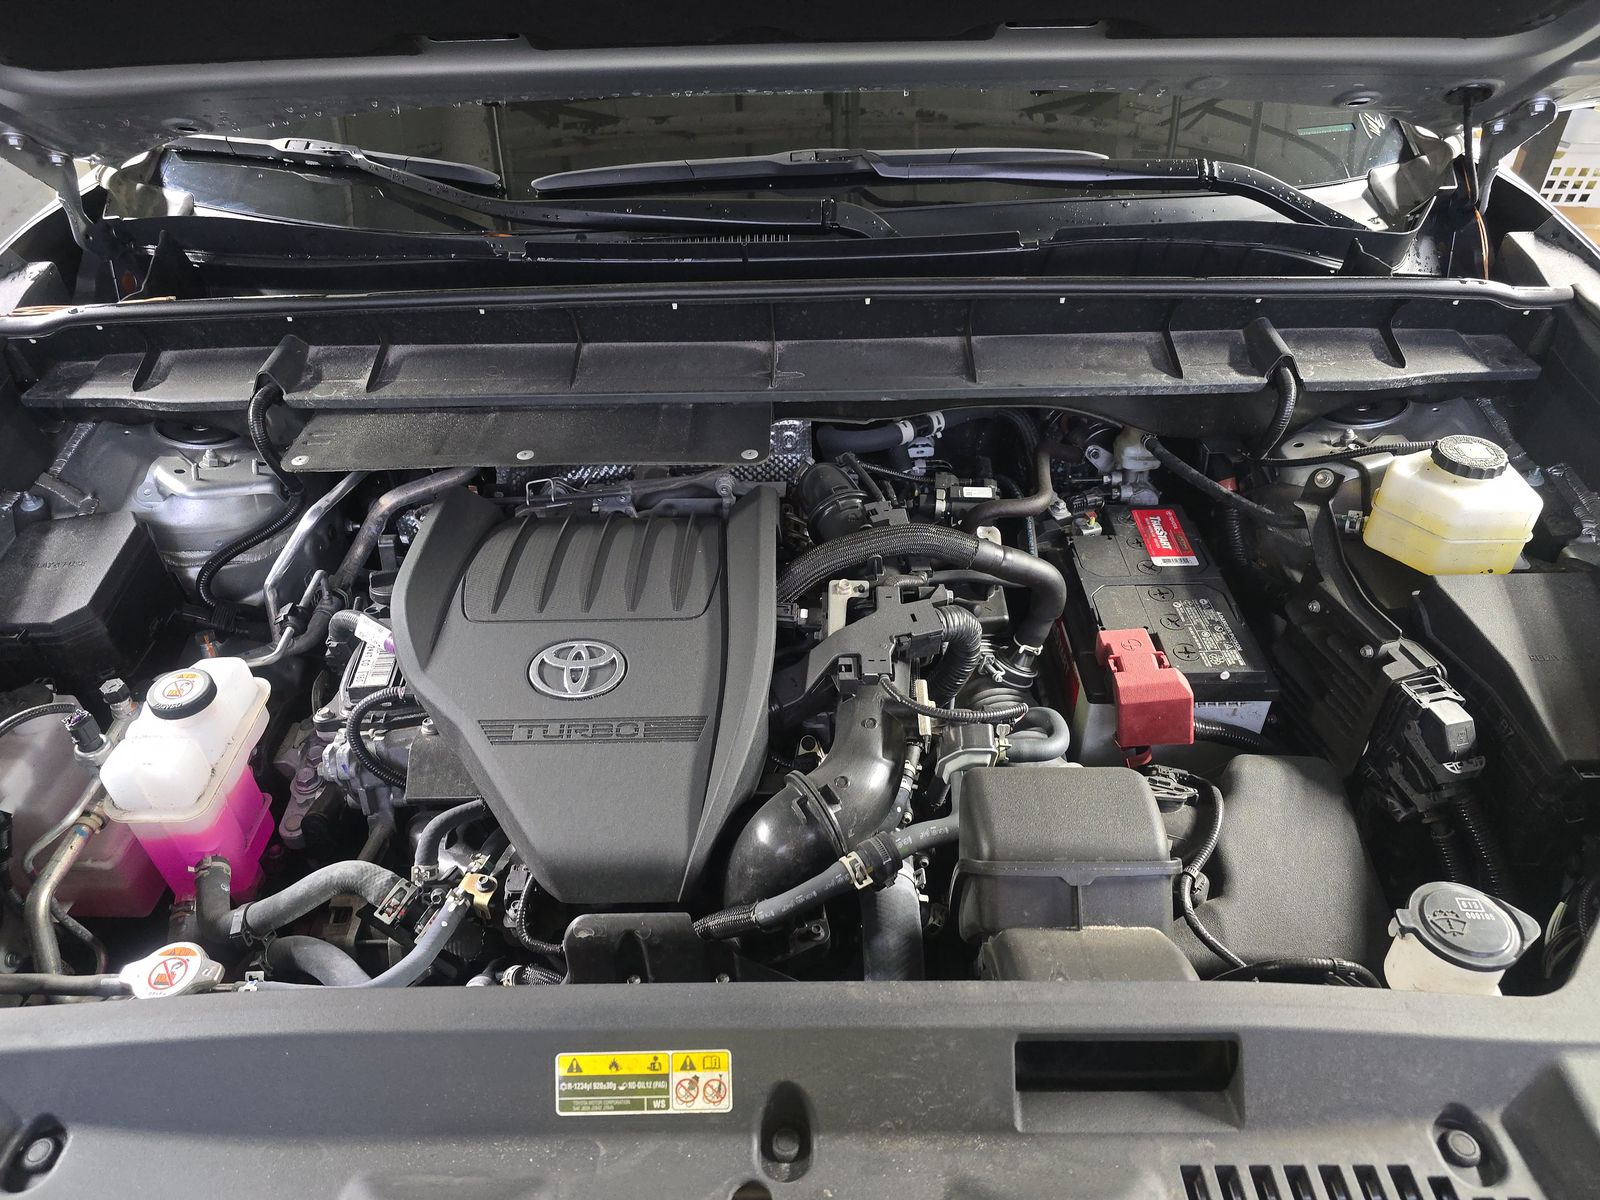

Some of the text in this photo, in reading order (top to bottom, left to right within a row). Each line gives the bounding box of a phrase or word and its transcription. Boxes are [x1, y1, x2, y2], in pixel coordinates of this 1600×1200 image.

[518, 721, 640, 740] TURBO
[567, 1082, 592, 1091] R-1234yf
[652, 1099, 666, 1108] WS
